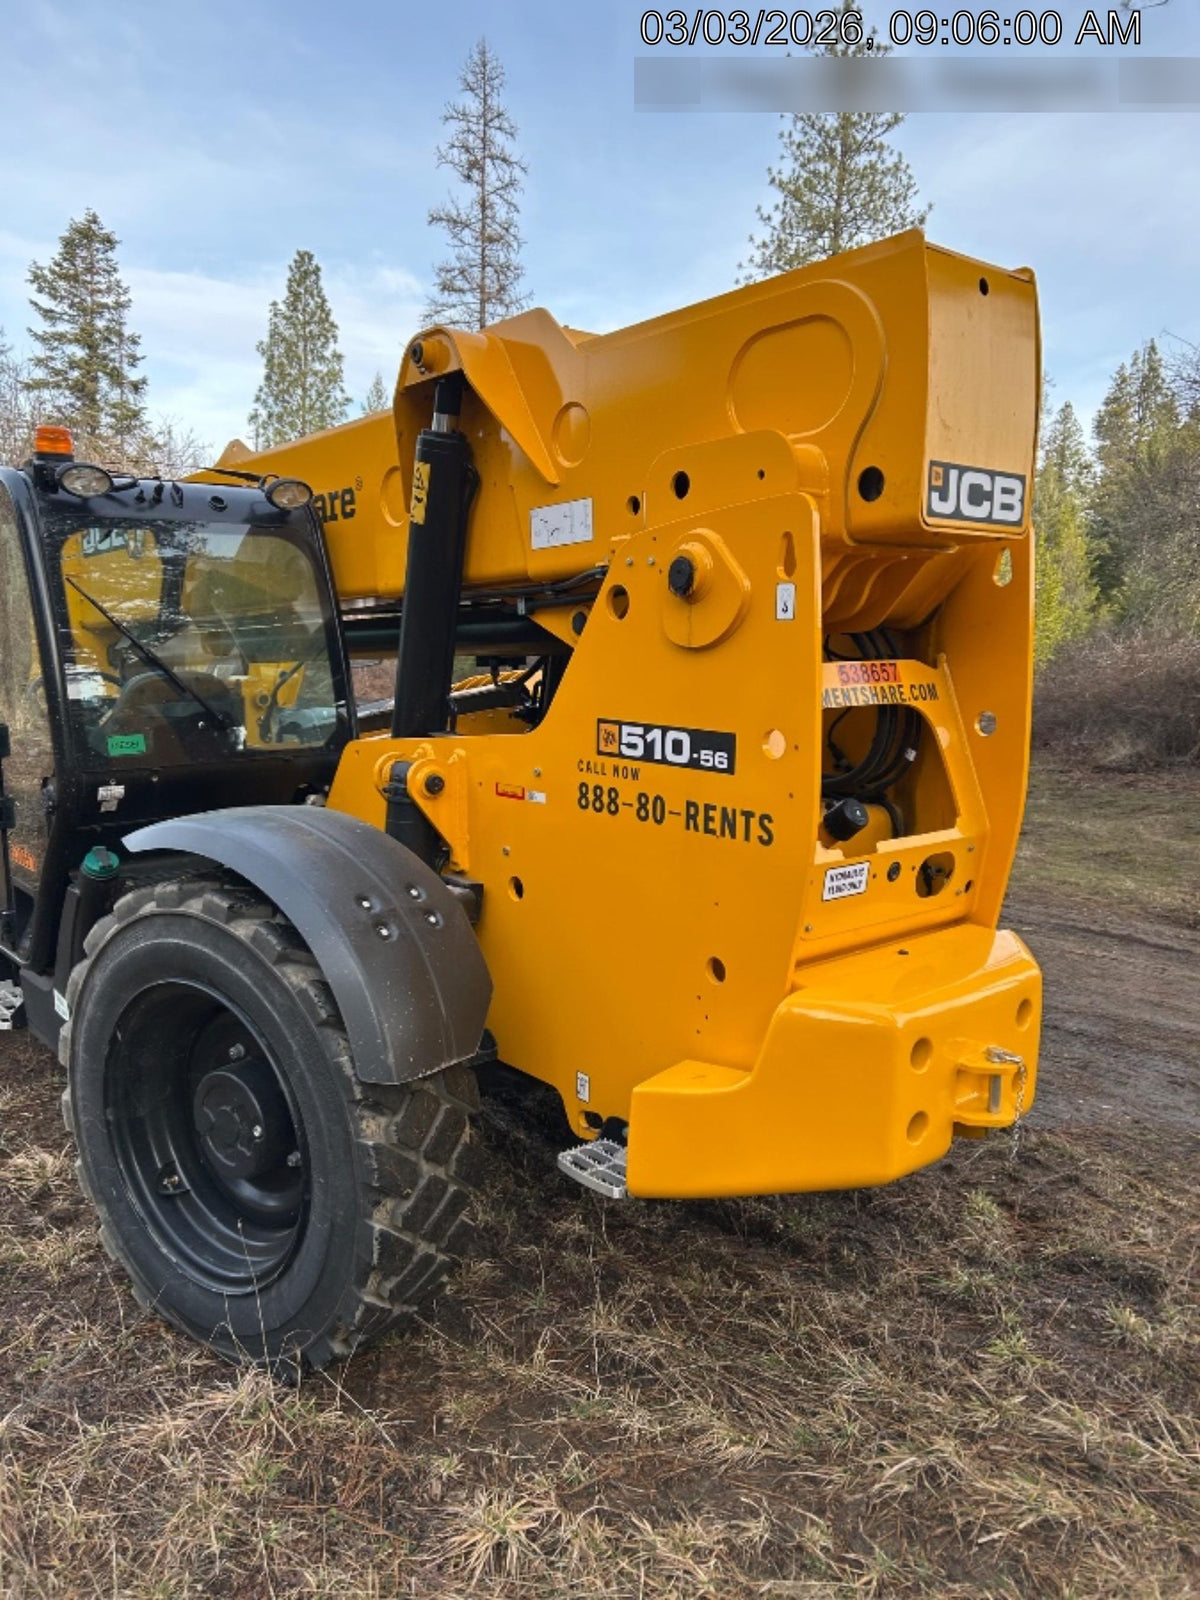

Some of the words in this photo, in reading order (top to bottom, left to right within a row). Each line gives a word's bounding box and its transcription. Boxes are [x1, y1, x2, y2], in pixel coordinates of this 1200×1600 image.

[931, 469, 1023, 521] JCB
[838, 662, 897, 684] 538657
[577, 759, 607, 776] CALL
[613, 766, 641, 781] NOW
[577, 781, 774, 846] 888-80-RENTS
